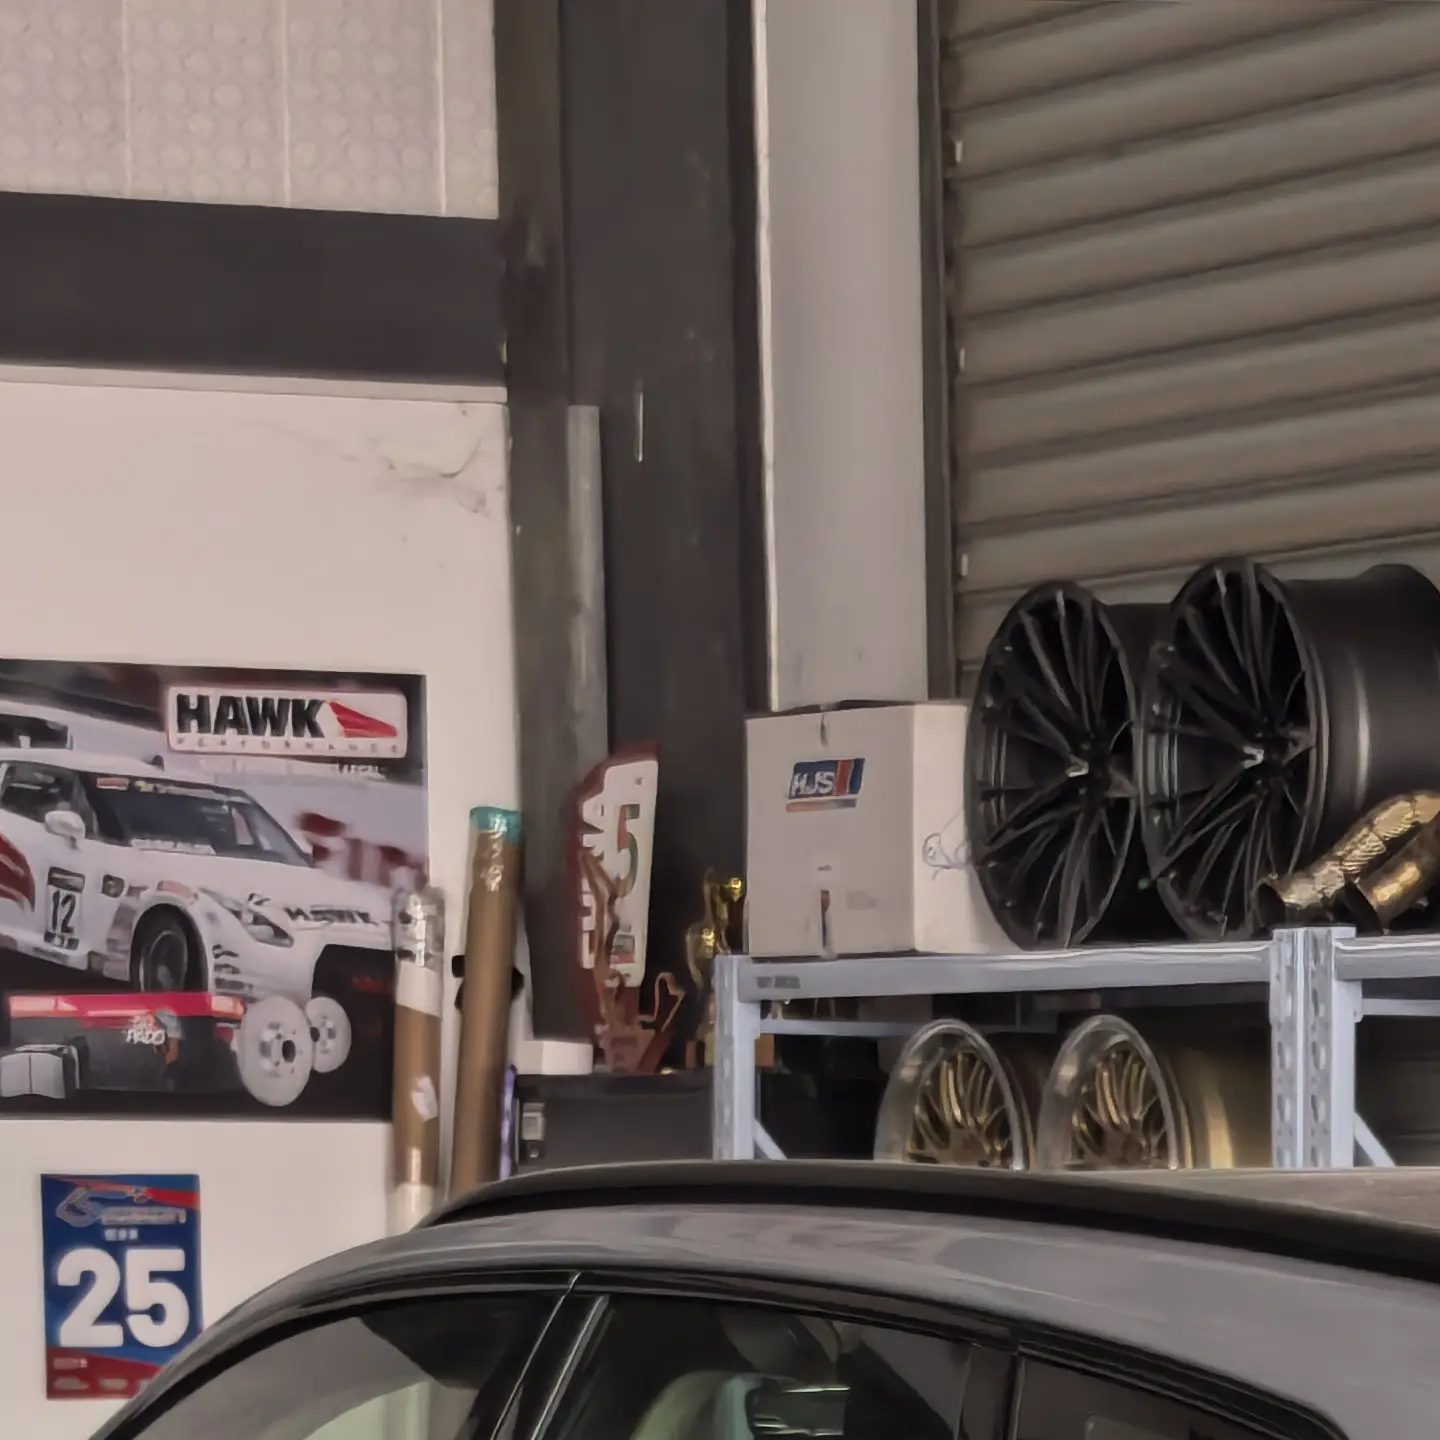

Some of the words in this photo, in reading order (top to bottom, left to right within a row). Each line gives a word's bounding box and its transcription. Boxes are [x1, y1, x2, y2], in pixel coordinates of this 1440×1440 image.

[176, 693, 326, 738] HAWK
[51, 889, 77, 935] 12
[57, 1247, 190, 1348] 25
